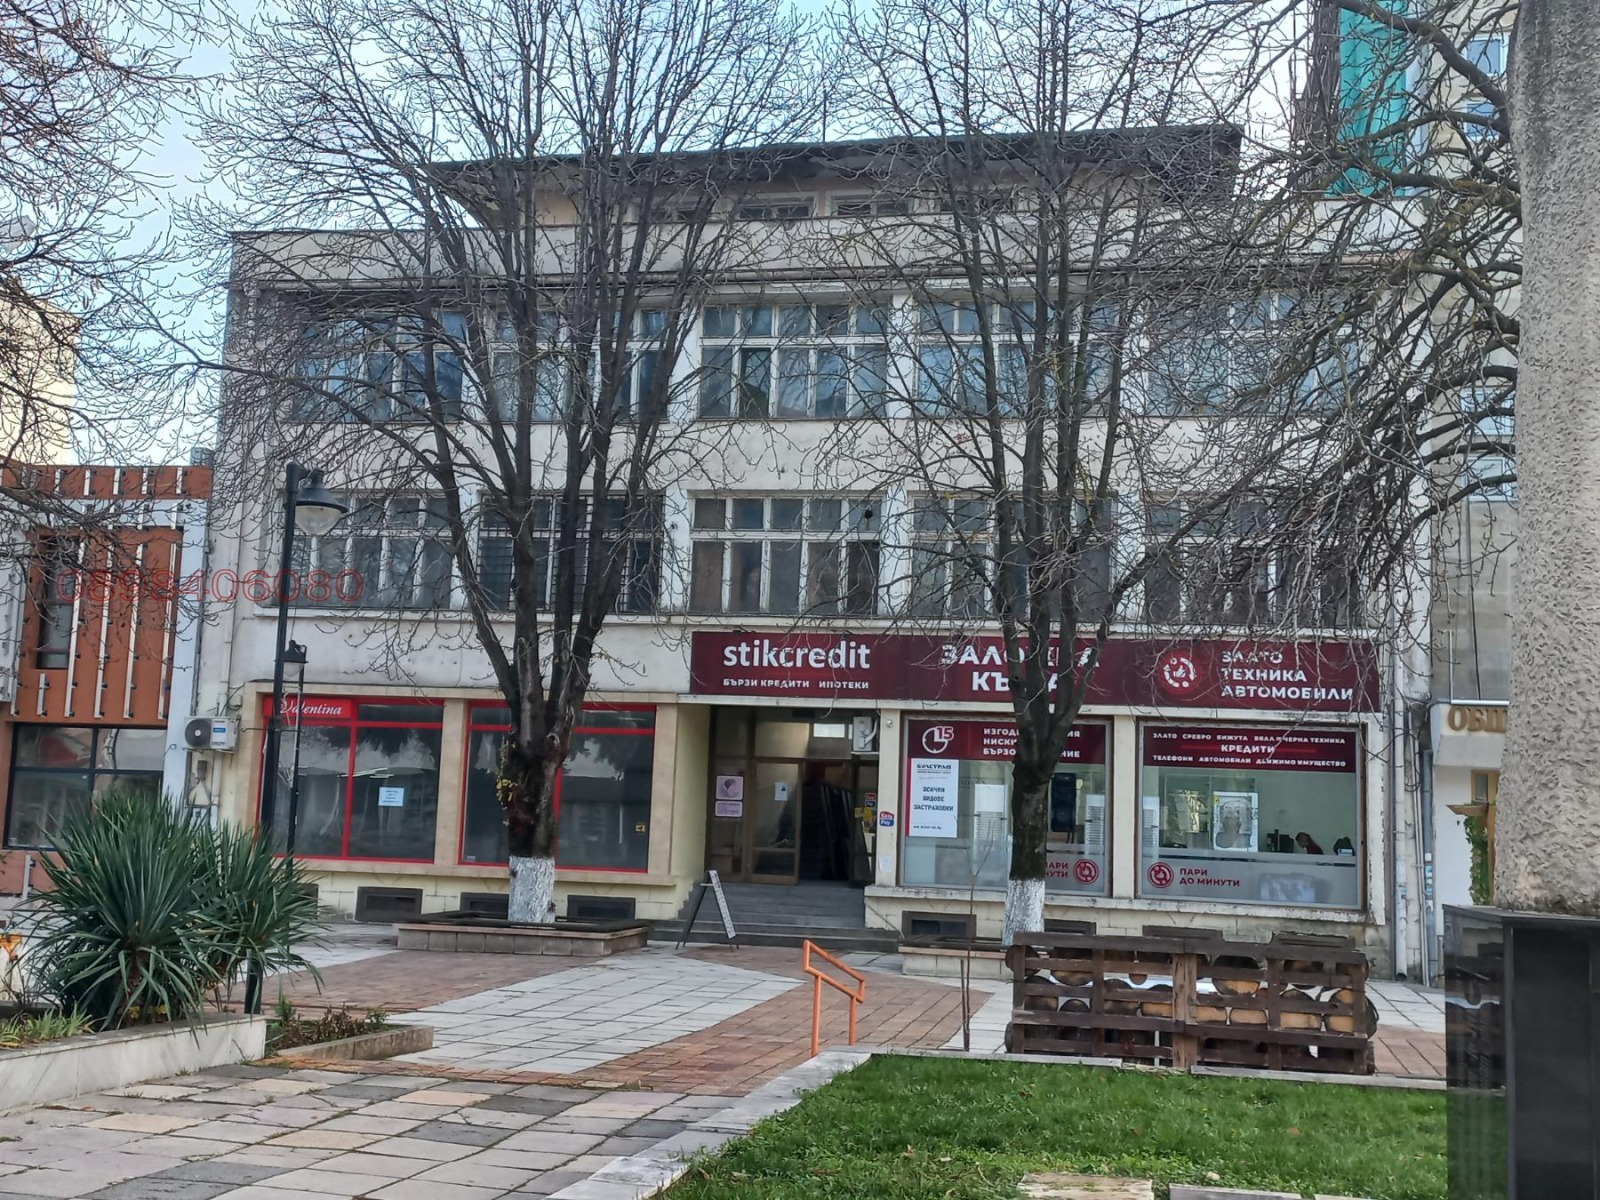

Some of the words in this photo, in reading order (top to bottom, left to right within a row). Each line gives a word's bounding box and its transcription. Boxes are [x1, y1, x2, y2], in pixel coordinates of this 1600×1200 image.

[723, 639, 871, 669] stikcredit
[1221, 668, 1307, 682] ТЕХНИКА
[723, 679, 758, 688] БЪРЗИ
[760, 680, 810, 689] КРЕДИТИ
[819, 681, 869, 689] ИПОТЕКИ
[1221, 685, 1354, 700] АВТОМОБИЛИ
[280, 699, 342, 715] Valentina
[936, 725, 954, 741] 15
[983, 747, 1016, 756] БЪРЗО
[1220, 744, 1275, 754] КРЕДИТИ
[1153, 754, 1194, 762] ТЕЛЕФОНИ
[1199, 756, 1252, 764] АВТОМОБИЛИ
[1297, 759, 1346, 767] ИМУЩЕСТВО
[1180, 867, 1208, 876] ПАРИ
[1179, 877, 1195, 886] ДО
[1197, 878, 1240, 887] МИНУТИ
